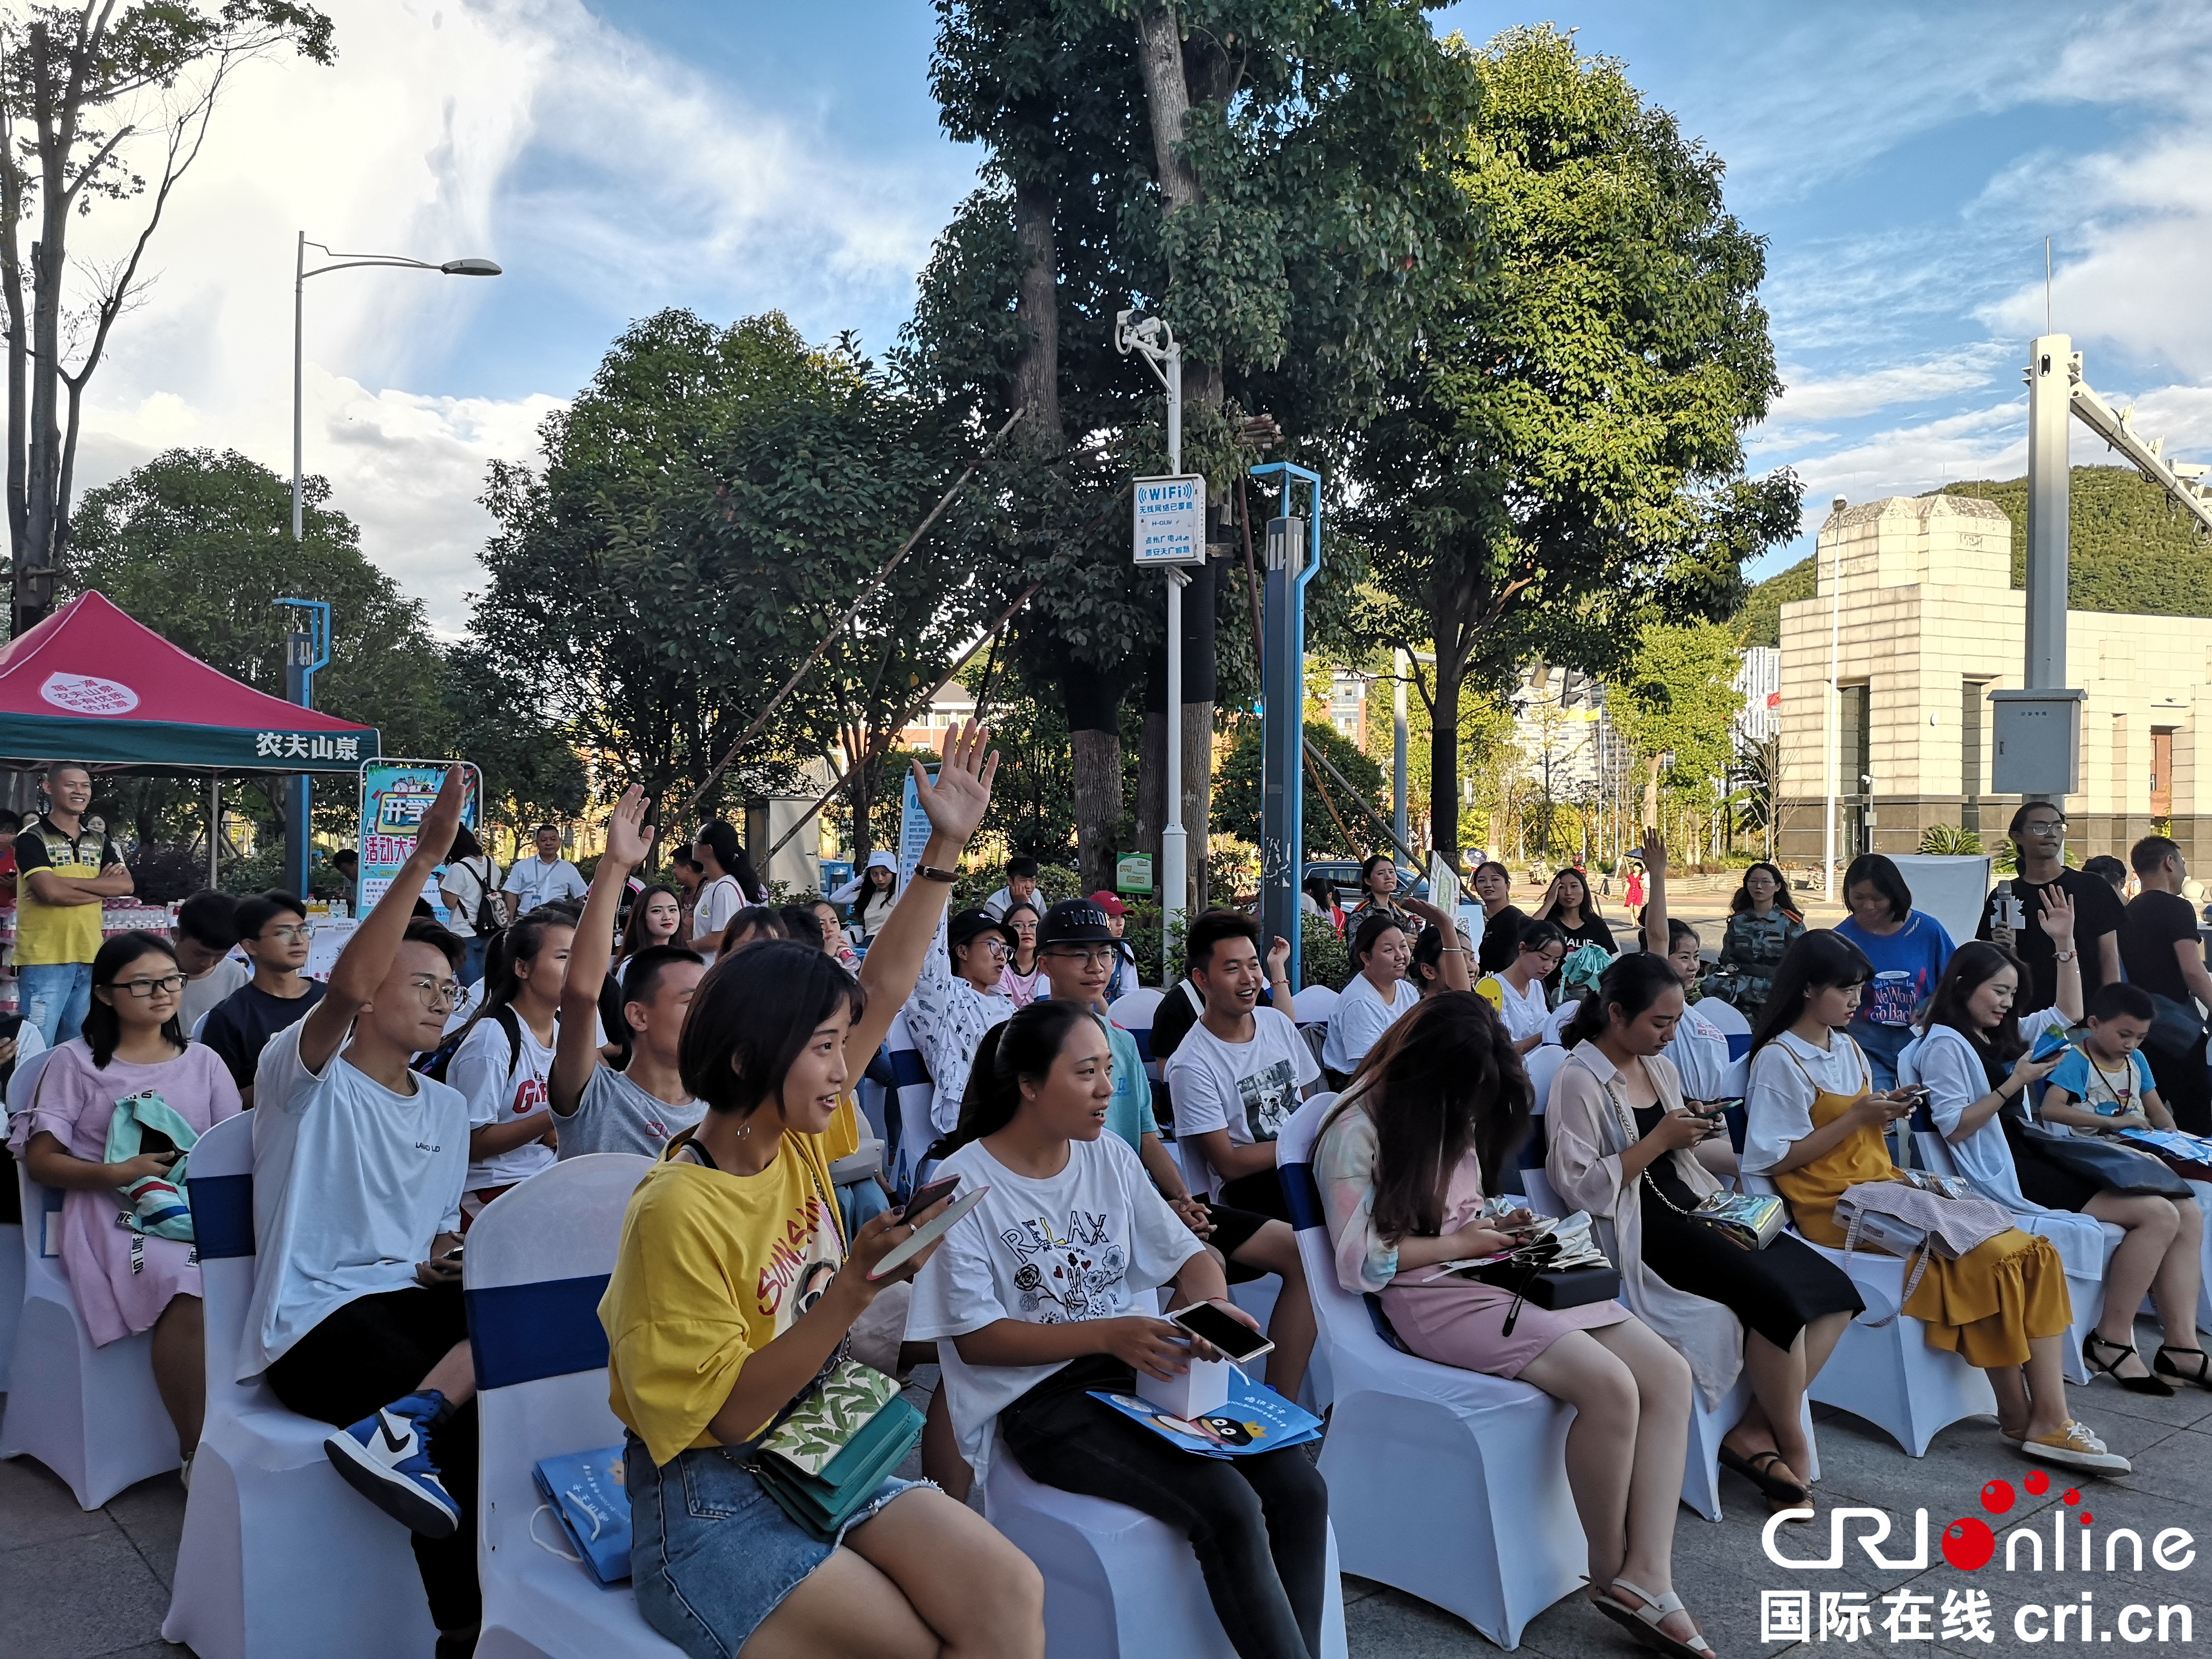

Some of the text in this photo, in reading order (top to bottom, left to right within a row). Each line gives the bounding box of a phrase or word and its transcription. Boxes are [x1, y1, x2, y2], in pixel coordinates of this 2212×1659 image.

[1139, 502, 1193, 514] 无线网络已覆盖
[51, 680, 98, 691] 每一滴
[54, 686, 116, 699] 农夫山泉
[83, 700, 130, 711] 的水源
[256, 732, 360, 760] 农夫山泉
[384, 799, 435, 824] 开学
[1001, 1211, 1109, 1264] RELAX
